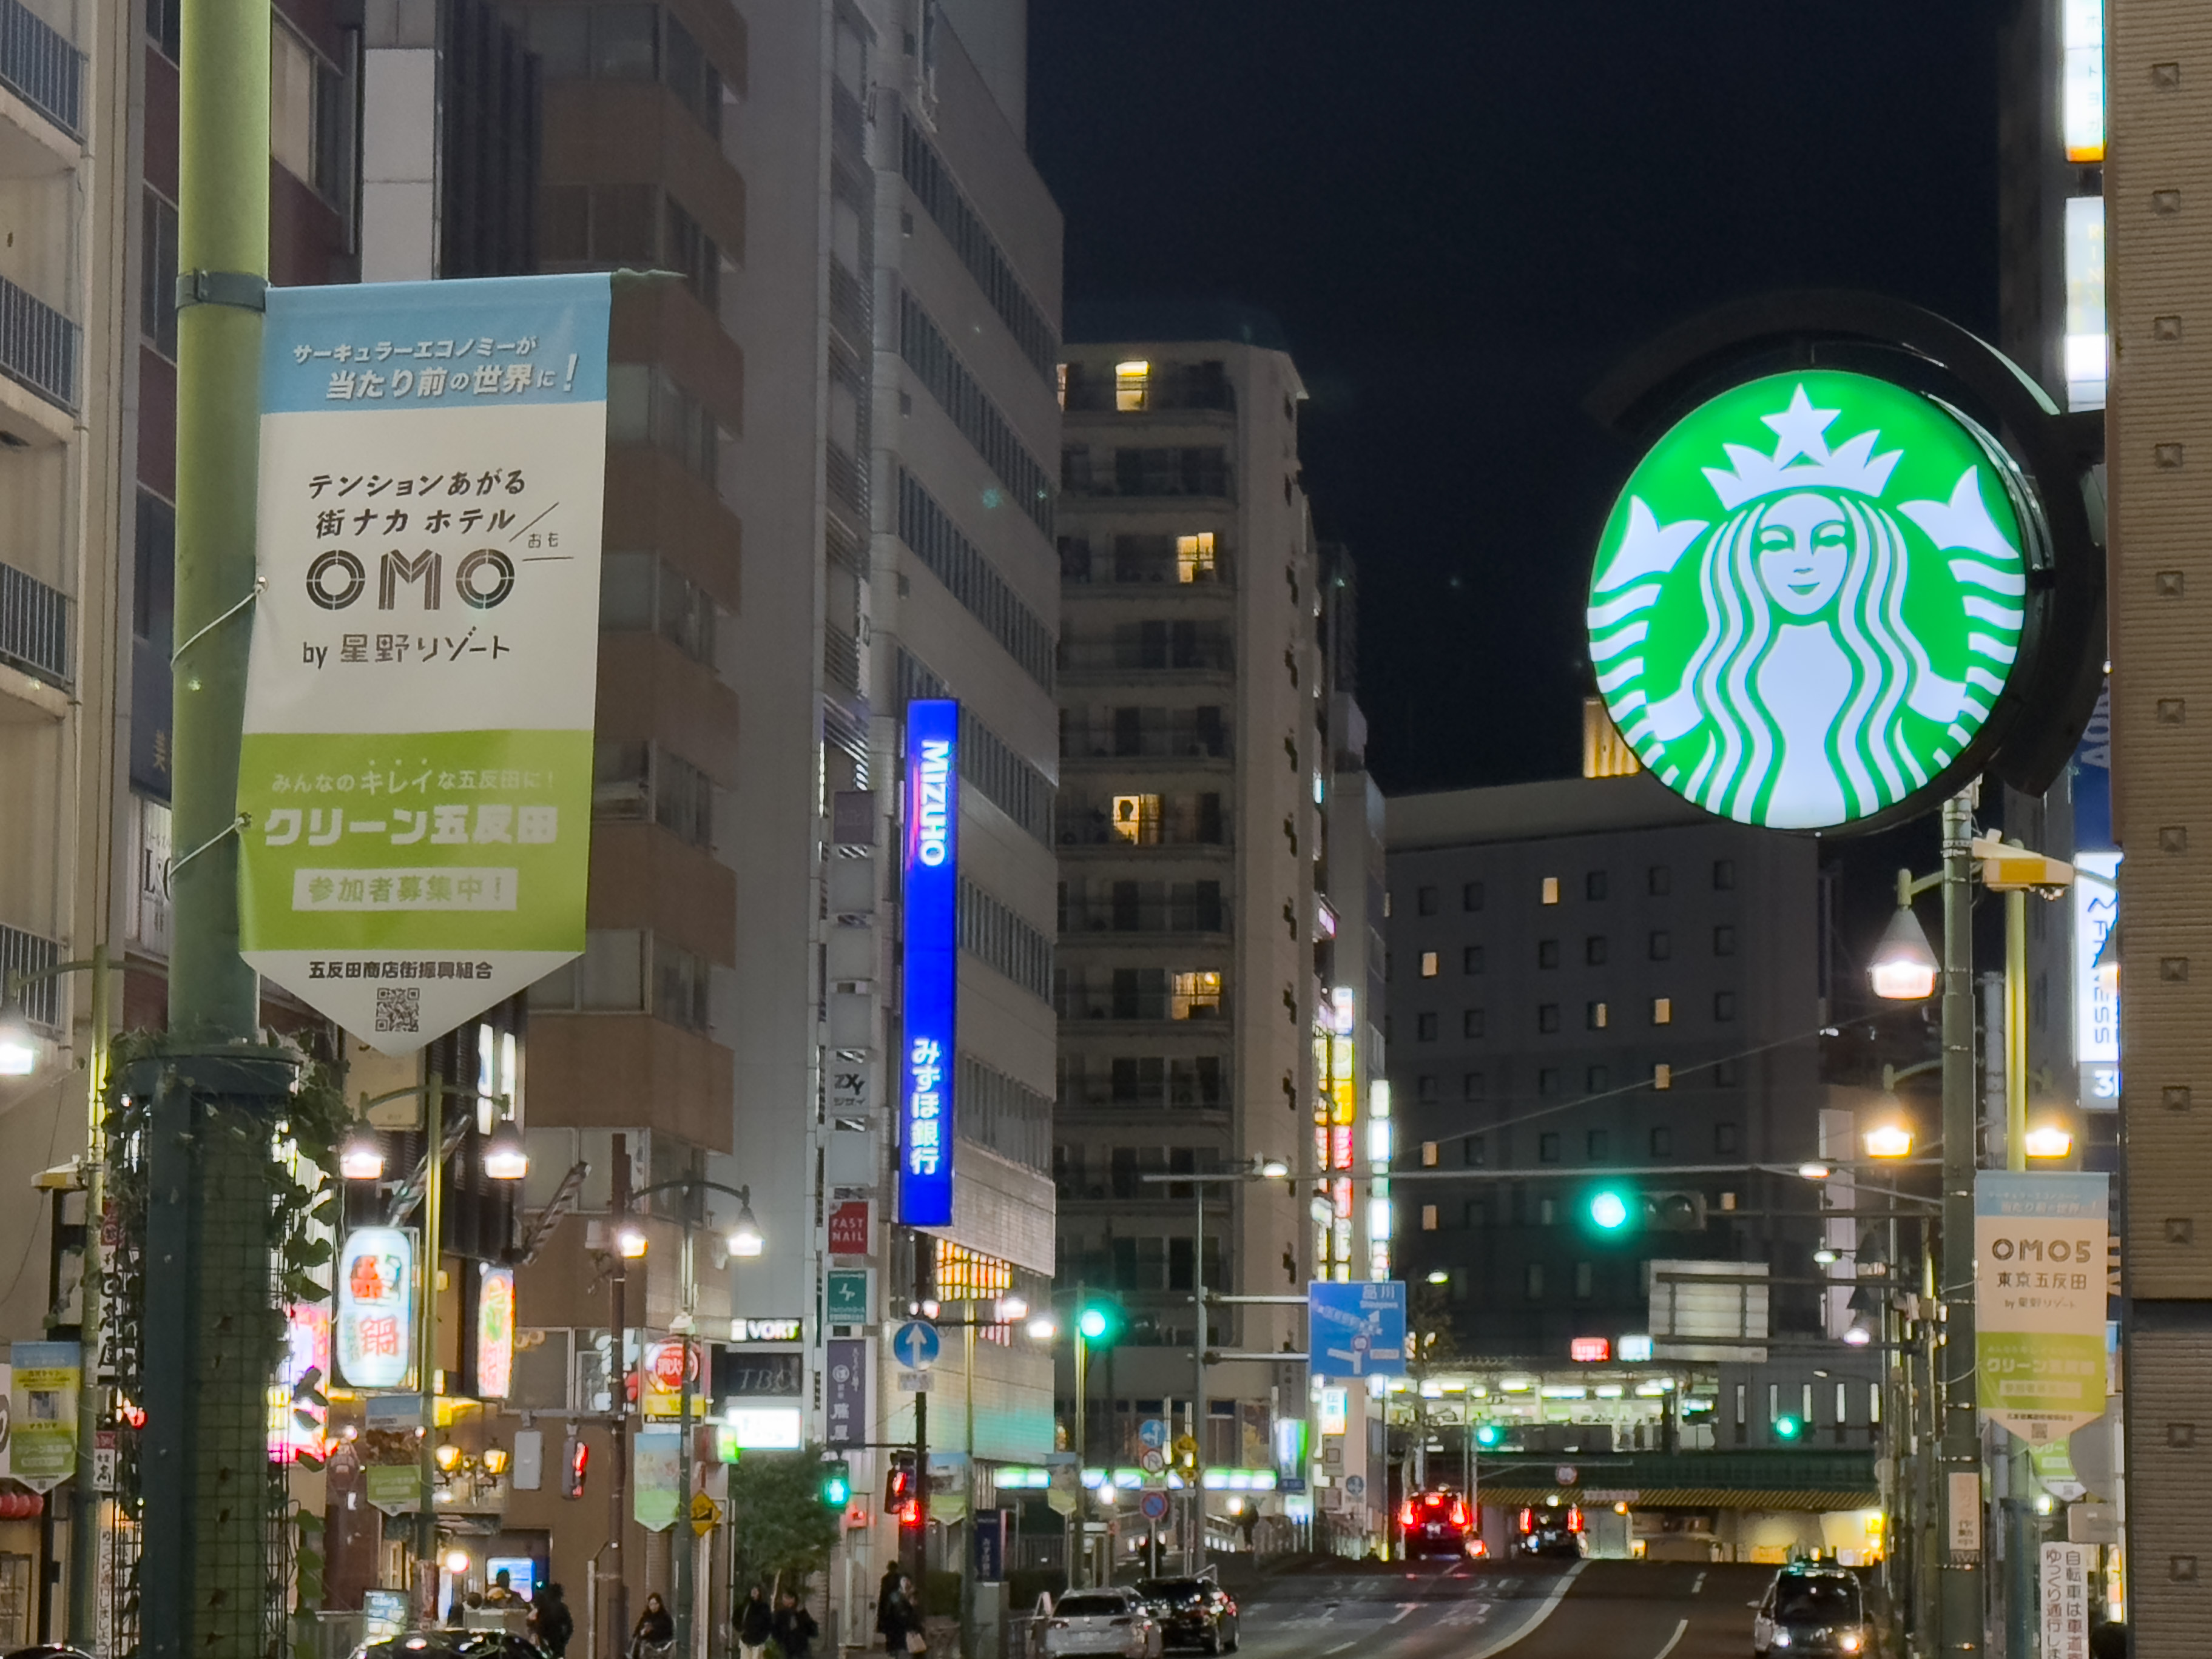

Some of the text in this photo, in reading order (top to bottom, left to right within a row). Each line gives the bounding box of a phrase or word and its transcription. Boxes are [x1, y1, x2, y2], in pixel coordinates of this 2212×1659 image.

[293, 335, 537, 364] サーキュラーエコノミーが
[326, 352, 579, 400] 当たり前の世界に!
[308, 469, 526, 499] テンションあがる
[527, 532, 560, 548] おも
[306, 548, 516, 611] OMO
[302, 625, 510, 670] by 星野リゾート
[920, 739, 950, 866] MIZUHO
[264, 804, 558, 847] クリーン五反田
[308, 874, 504, 904] 参加者募集中!
[308, 961, 493, 980] 五反田商店街振興組合
[833, 1072, 866, 1095] ZXY
[911, 1038, 941, 1176] みずほ銀行
[831, 1219, 865, 1229] FAST
[831, 1231, 865, 1242] NAIL
[1991, 1238, 2092, 1264] OMO5
[1997, 1271, 2088, 1291] 東京五反田
[747, 1319, 800, 1339] VORT
[2066, 1550, 2083, 1659] 自転車は車道
